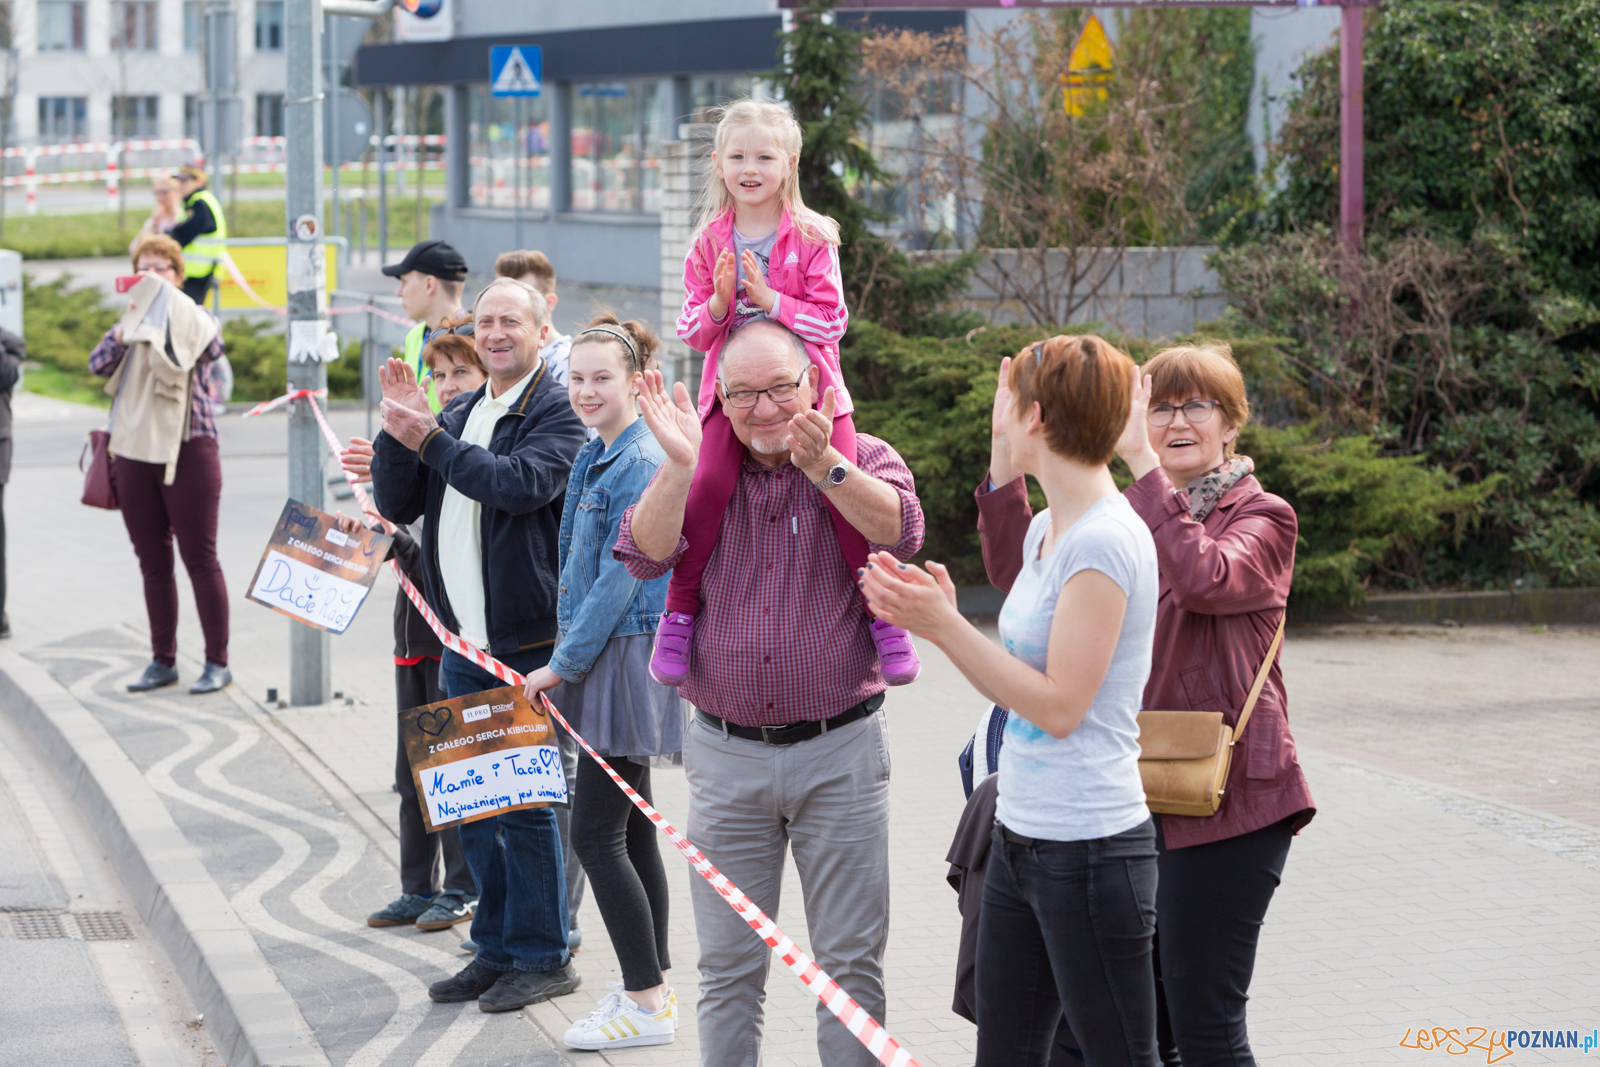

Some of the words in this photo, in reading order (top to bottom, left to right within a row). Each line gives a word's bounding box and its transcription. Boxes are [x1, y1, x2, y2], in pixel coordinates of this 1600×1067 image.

[287, 536, 294, 545] Z
[293, 539, 323, 558] CAŁEGO
[323, 551, 343, 566] SERCA
[260, 559, 316, 613] Dacie
[474, 708, 489, 716] PKO
[428, 745, 435, 754] Z
[436, 736, 475, 752] CAŁEGO
[476, 728, 506, 742] SERCA
[428, 769, 484, 797] Mamie
[491, 763, 500, 777] i
